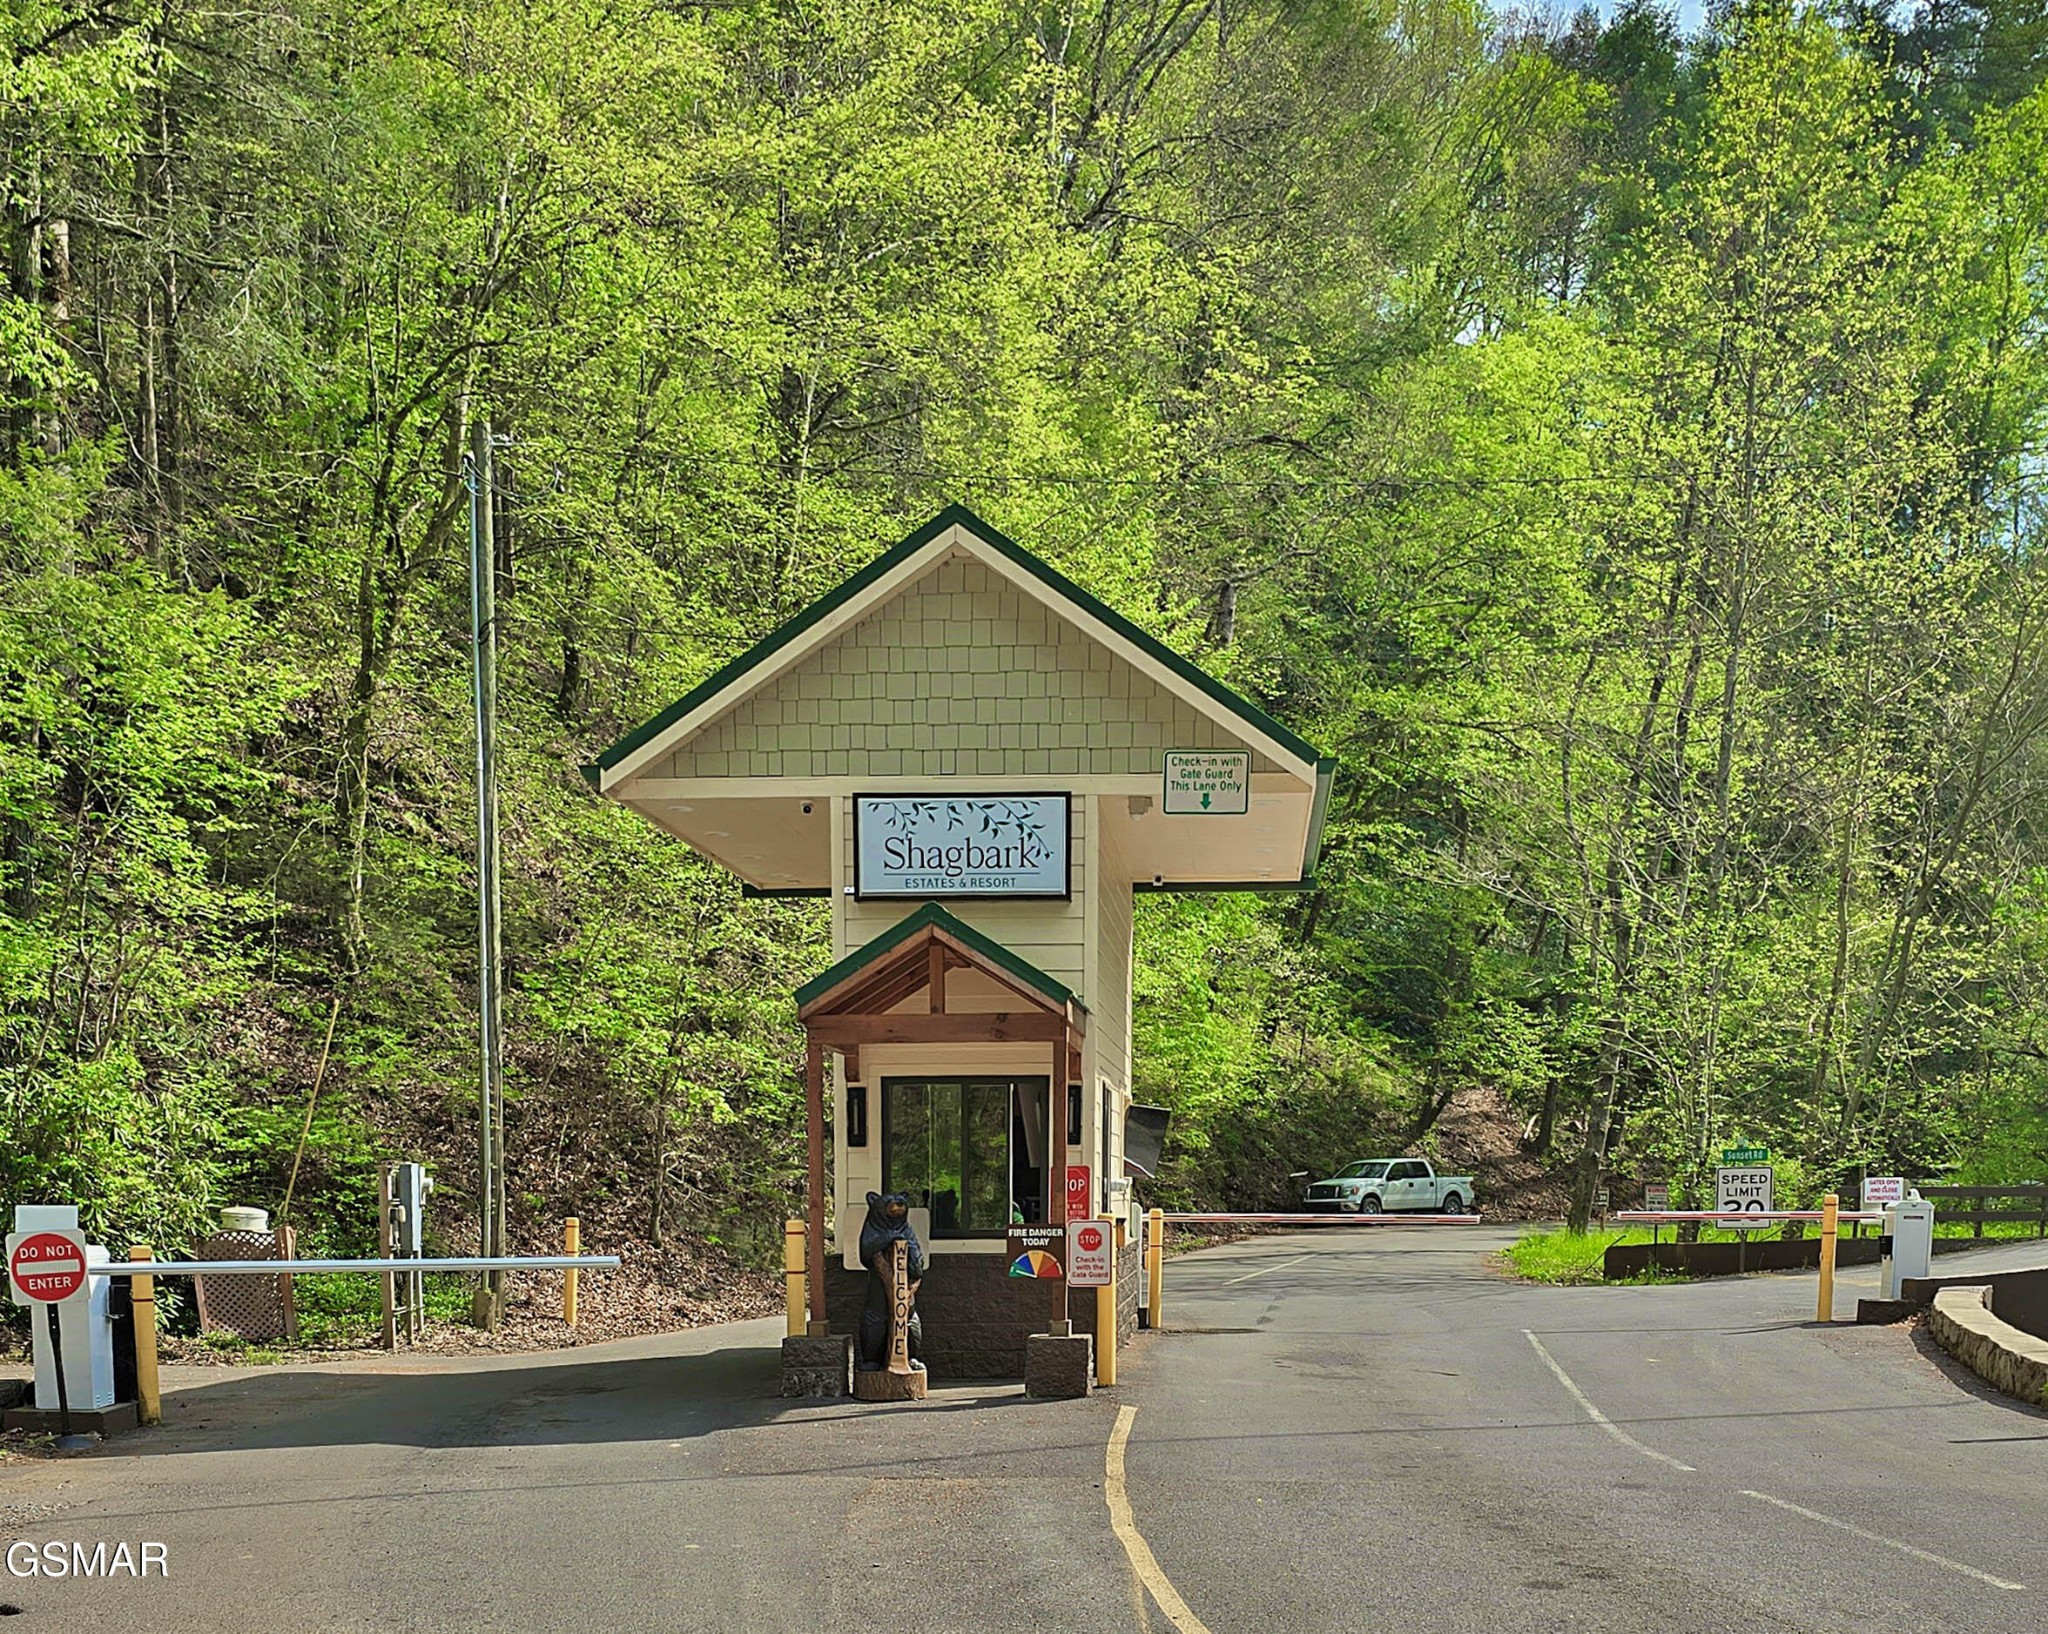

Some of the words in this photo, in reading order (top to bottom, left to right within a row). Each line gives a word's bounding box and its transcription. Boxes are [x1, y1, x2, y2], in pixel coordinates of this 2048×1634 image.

[1171, 756, 1217, 767] Check-in
[1221, 756, 1243, 767] with
[1180, 768, 1202, 779] Gate
[1205, 768, 1233, 779] Guard
[1170, 780, 1190, 791] This
[1193, 780, 1217, 791] Lane
[1219, 780, 1242, 793] Only
[883, 836, 1039, 877] Shagbark
[905, 877, 956, 889] ESTATES
[959, 877, 967, 889] &
[970, 877, 1017, 888] RESORT
[1727, 1150, 1752, 1160] Sunset
[1754, 1150, 1763, 1159] Rd
[1068, 1178, 1086, 1192] OP
[1721, 1174, 1768, 1185] SPEED
[1726, 1187, 1762, 1197] LIMIT
[1008, 1228, 1028, 1237] FIRE
[1028, 1228, 1064, 1237] DANGER
[1022, 1238, 1050, 1246] TODAY
[1079, 1234, 1101, 1244] STOP
[19, 1247, 39, 1259] DO
[45, 1244, 73, 1258] NOT
[28, 1276, 72, 1290] ENTER
[894, 1242, 908, 1355] WELCOME
